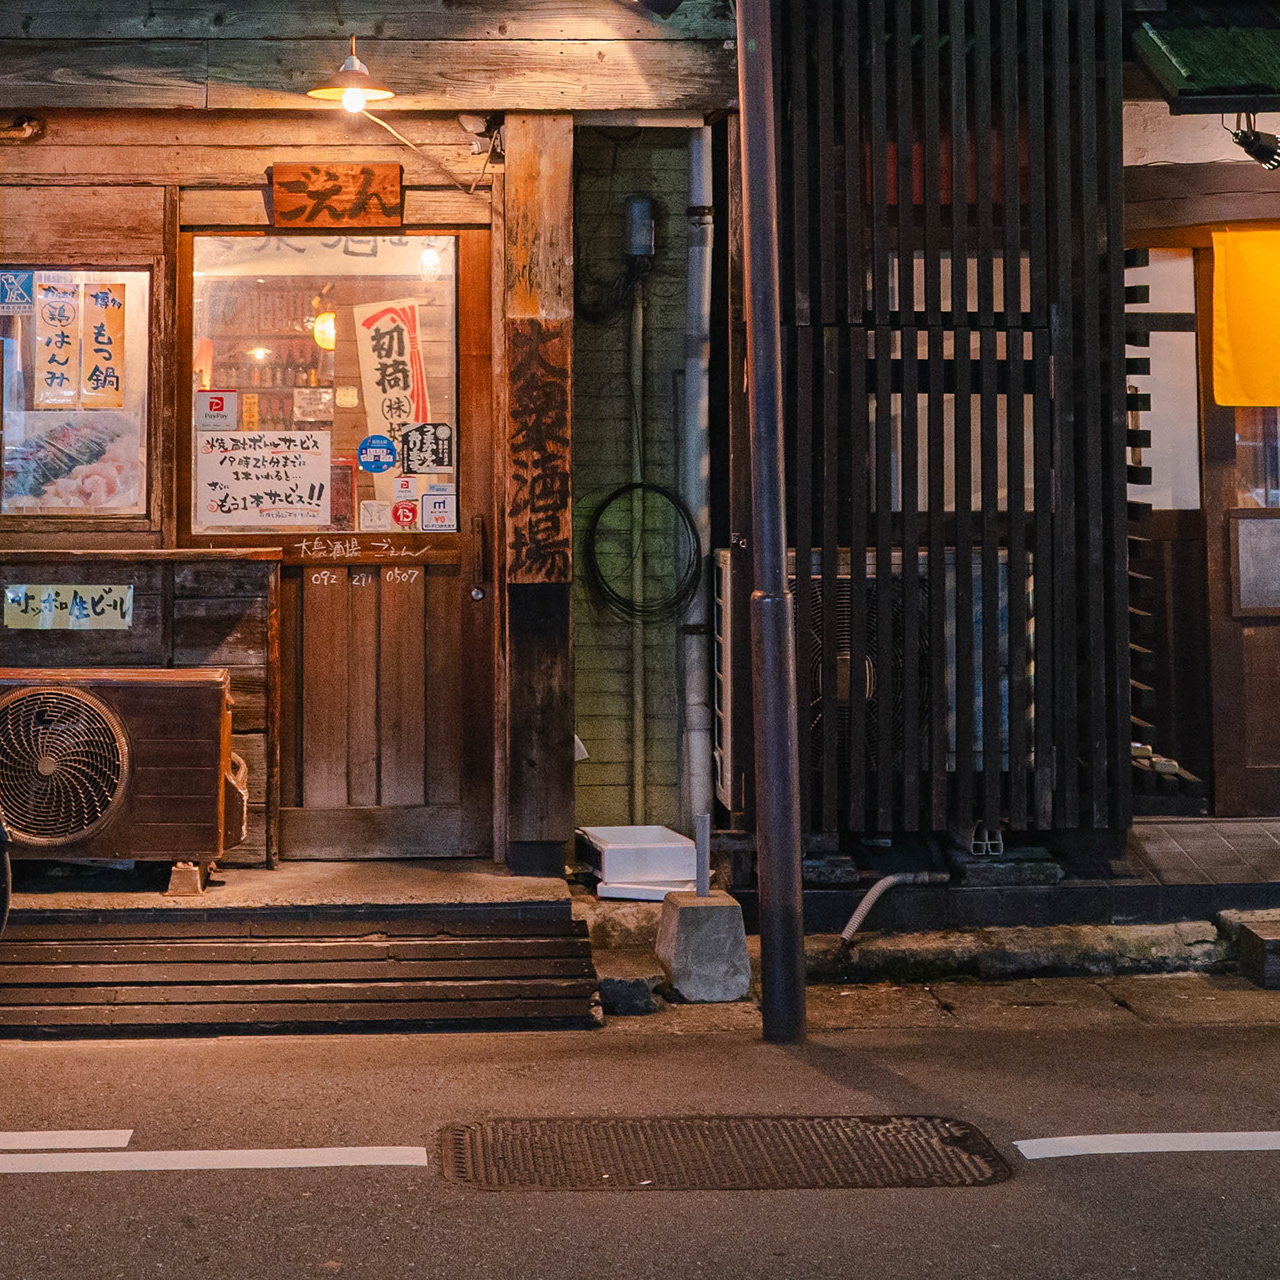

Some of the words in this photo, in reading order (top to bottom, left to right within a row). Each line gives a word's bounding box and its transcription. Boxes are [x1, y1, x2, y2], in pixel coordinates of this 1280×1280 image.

[276, 166, 401, 222] ごえん
[90, 288, 122, 309] 博多
[87, 322, 120, 391] もつ鍋
[371, 324, 410, 394] 初荷
[204, 412, 228, 420] PayPay
[205, 434, 320, 451] 焼酎ボトルサービス
[219, 455, 306, 469] 19時25分までに
[311, 570, 338, 586] 092
[385, 566, 420, 584] 0507
